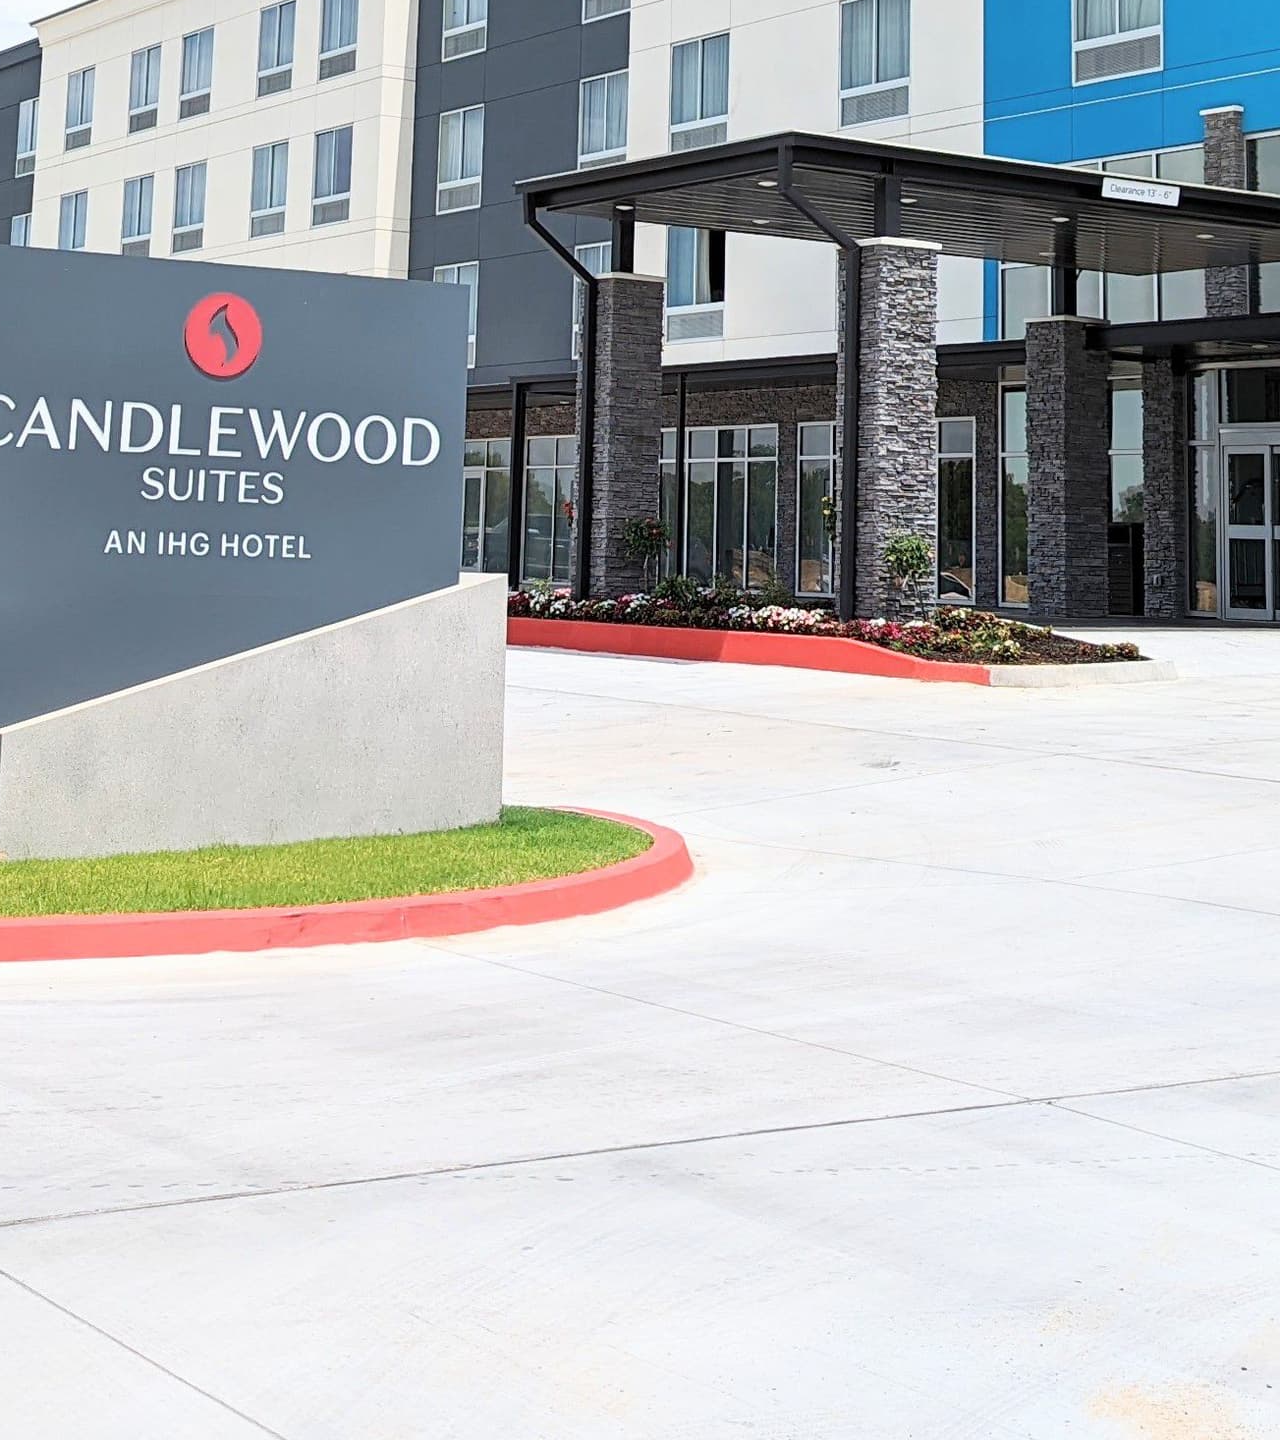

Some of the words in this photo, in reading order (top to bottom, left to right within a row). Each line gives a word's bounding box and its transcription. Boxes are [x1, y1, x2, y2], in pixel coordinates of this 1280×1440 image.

[1110, 183, 1145, 196] Clearance
[140, 467, 284, 505] SUITES
[104, 530, 146, 554] AN
[158, 531, 210, 556] IHG
[221, 533, 312, 559] HOTEL
